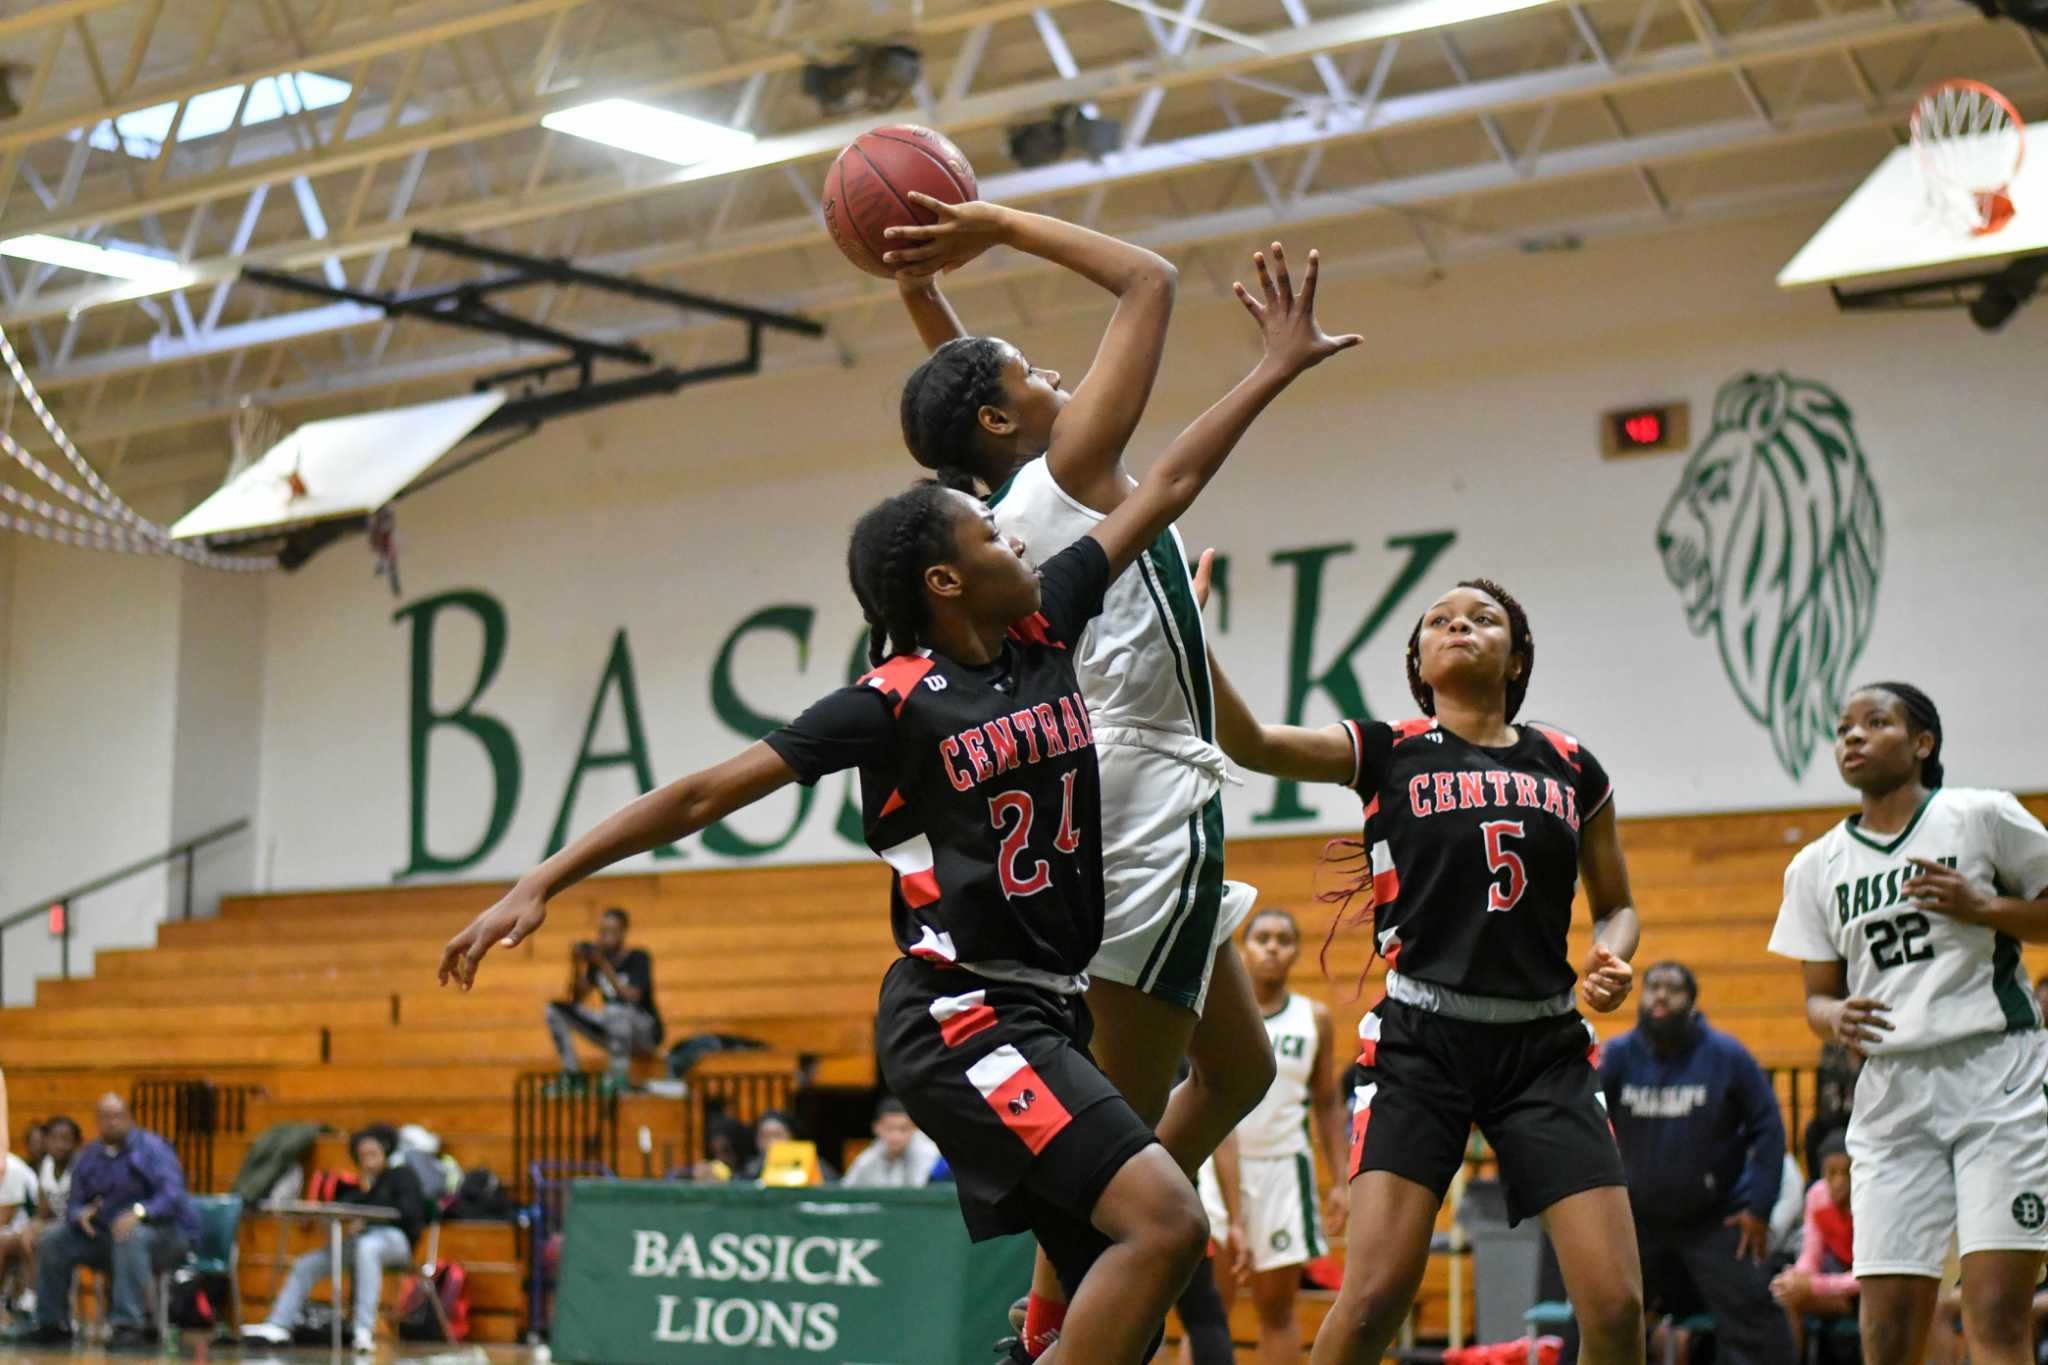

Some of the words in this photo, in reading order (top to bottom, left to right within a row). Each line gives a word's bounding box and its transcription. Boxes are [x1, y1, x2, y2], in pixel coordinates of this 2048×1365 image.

[391, 529, 1457, 880] BASK
[1409, 770, 1581, 832] CENTRAL
[1479, 819, 1528, 912] 5
[1835, 855, 1957, 928] BASSI
[1864, 911, 1935, 973] 22
[629, 1229, 882, 1287] BASSICK
[654, 1295, 840, 1352] LIONS
